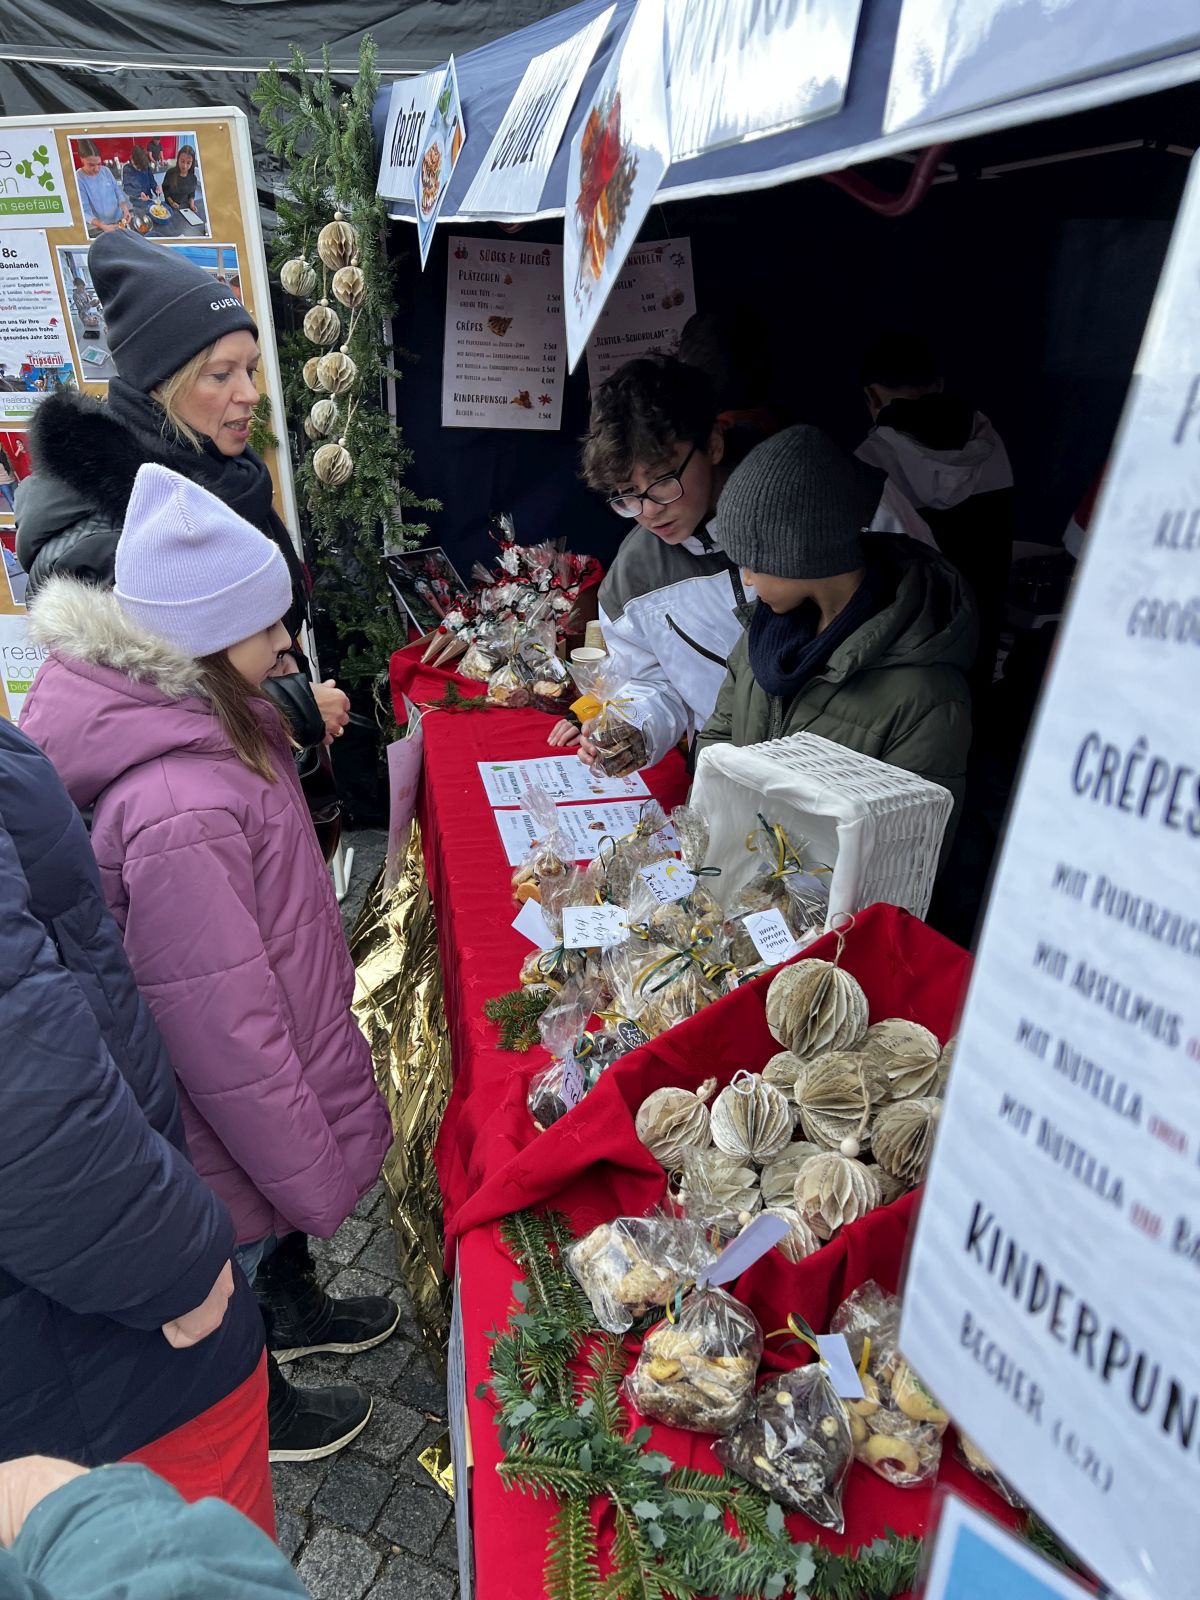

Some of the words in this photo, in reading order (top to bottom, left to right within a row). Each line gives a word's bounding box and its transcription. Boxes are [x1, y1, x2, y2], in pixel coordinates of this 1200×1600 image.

[390, 98, 426, 168] CRÊPES
[11, 199, 60, 212] seefälle
[3, 248, 18, 258] 8c
[456, 320, 483, 332] CRÊPES
[27, 355, 64, 366] Tripsdrill
[453, 393, 508, 405] KINDERPUNSCH
[1070, 959, 1184, 1051] APFELMUS
[1053, 1038, 1144, 1126] NUTELLA
[1036, 1115, 1124, 1211] NUTELLA
[959, 1310, 1046, 1426] BECHER
